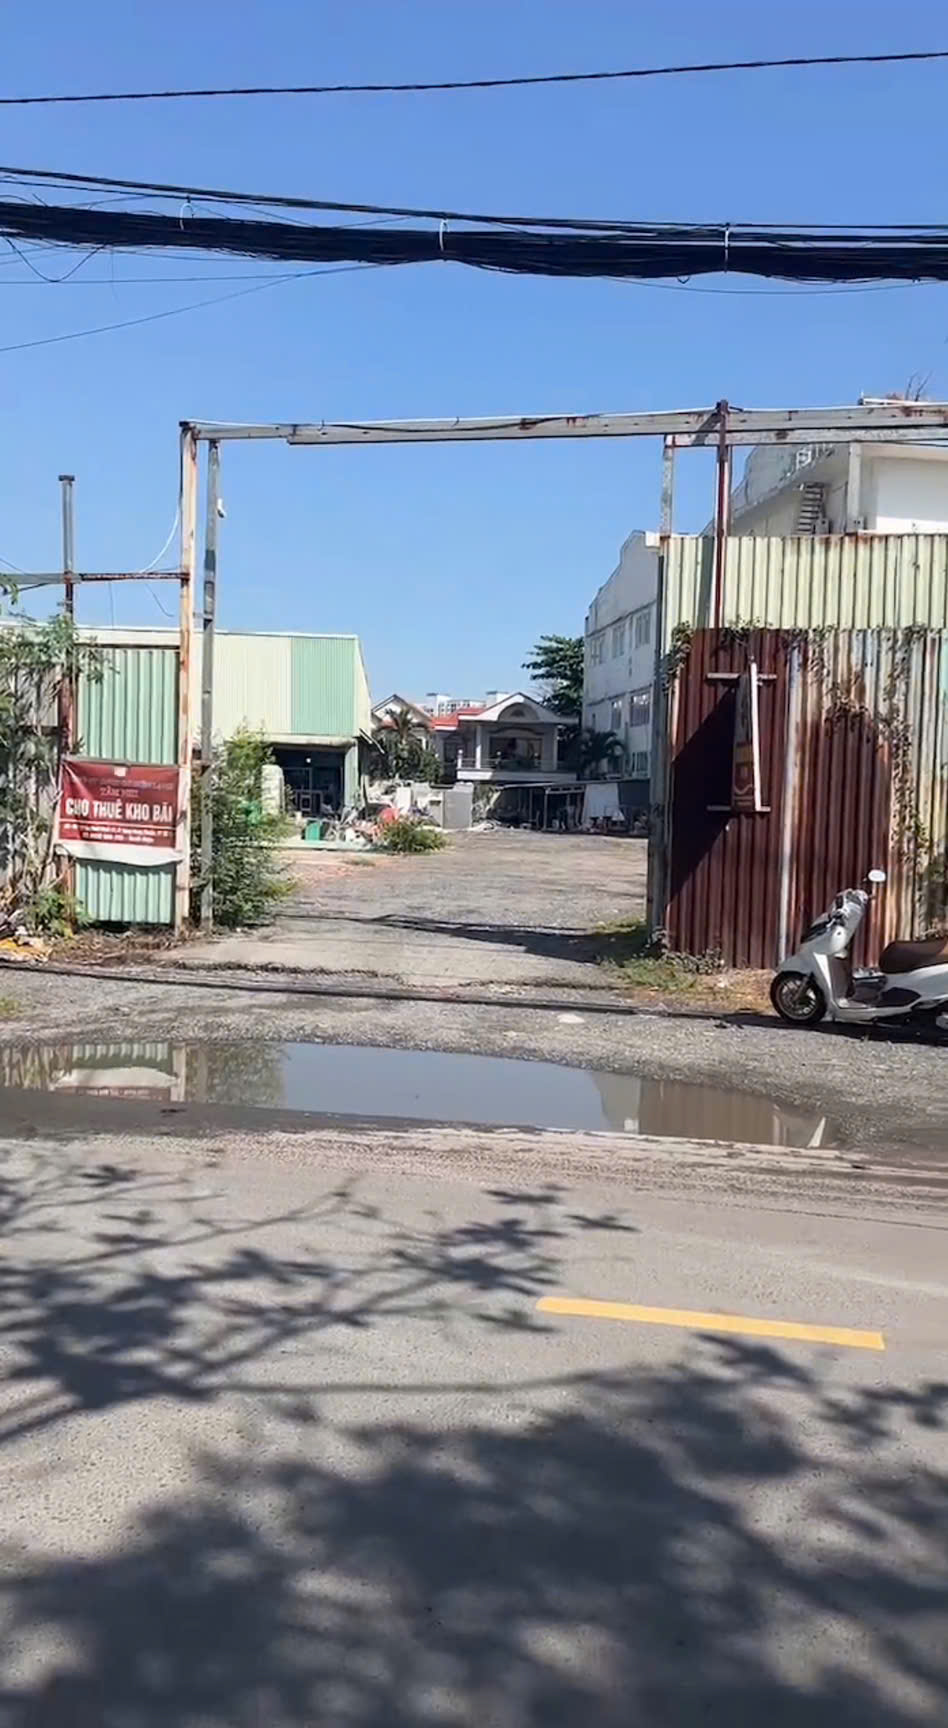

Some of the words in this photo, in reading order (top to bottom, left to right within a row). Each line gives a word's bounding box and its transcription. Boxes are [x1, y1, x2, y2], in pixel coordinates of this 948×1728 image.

[93, 798, 123, 819] THUÊ
[125, 802, 151, 821] KHO
[153, 801, 173, 823] BÃI
